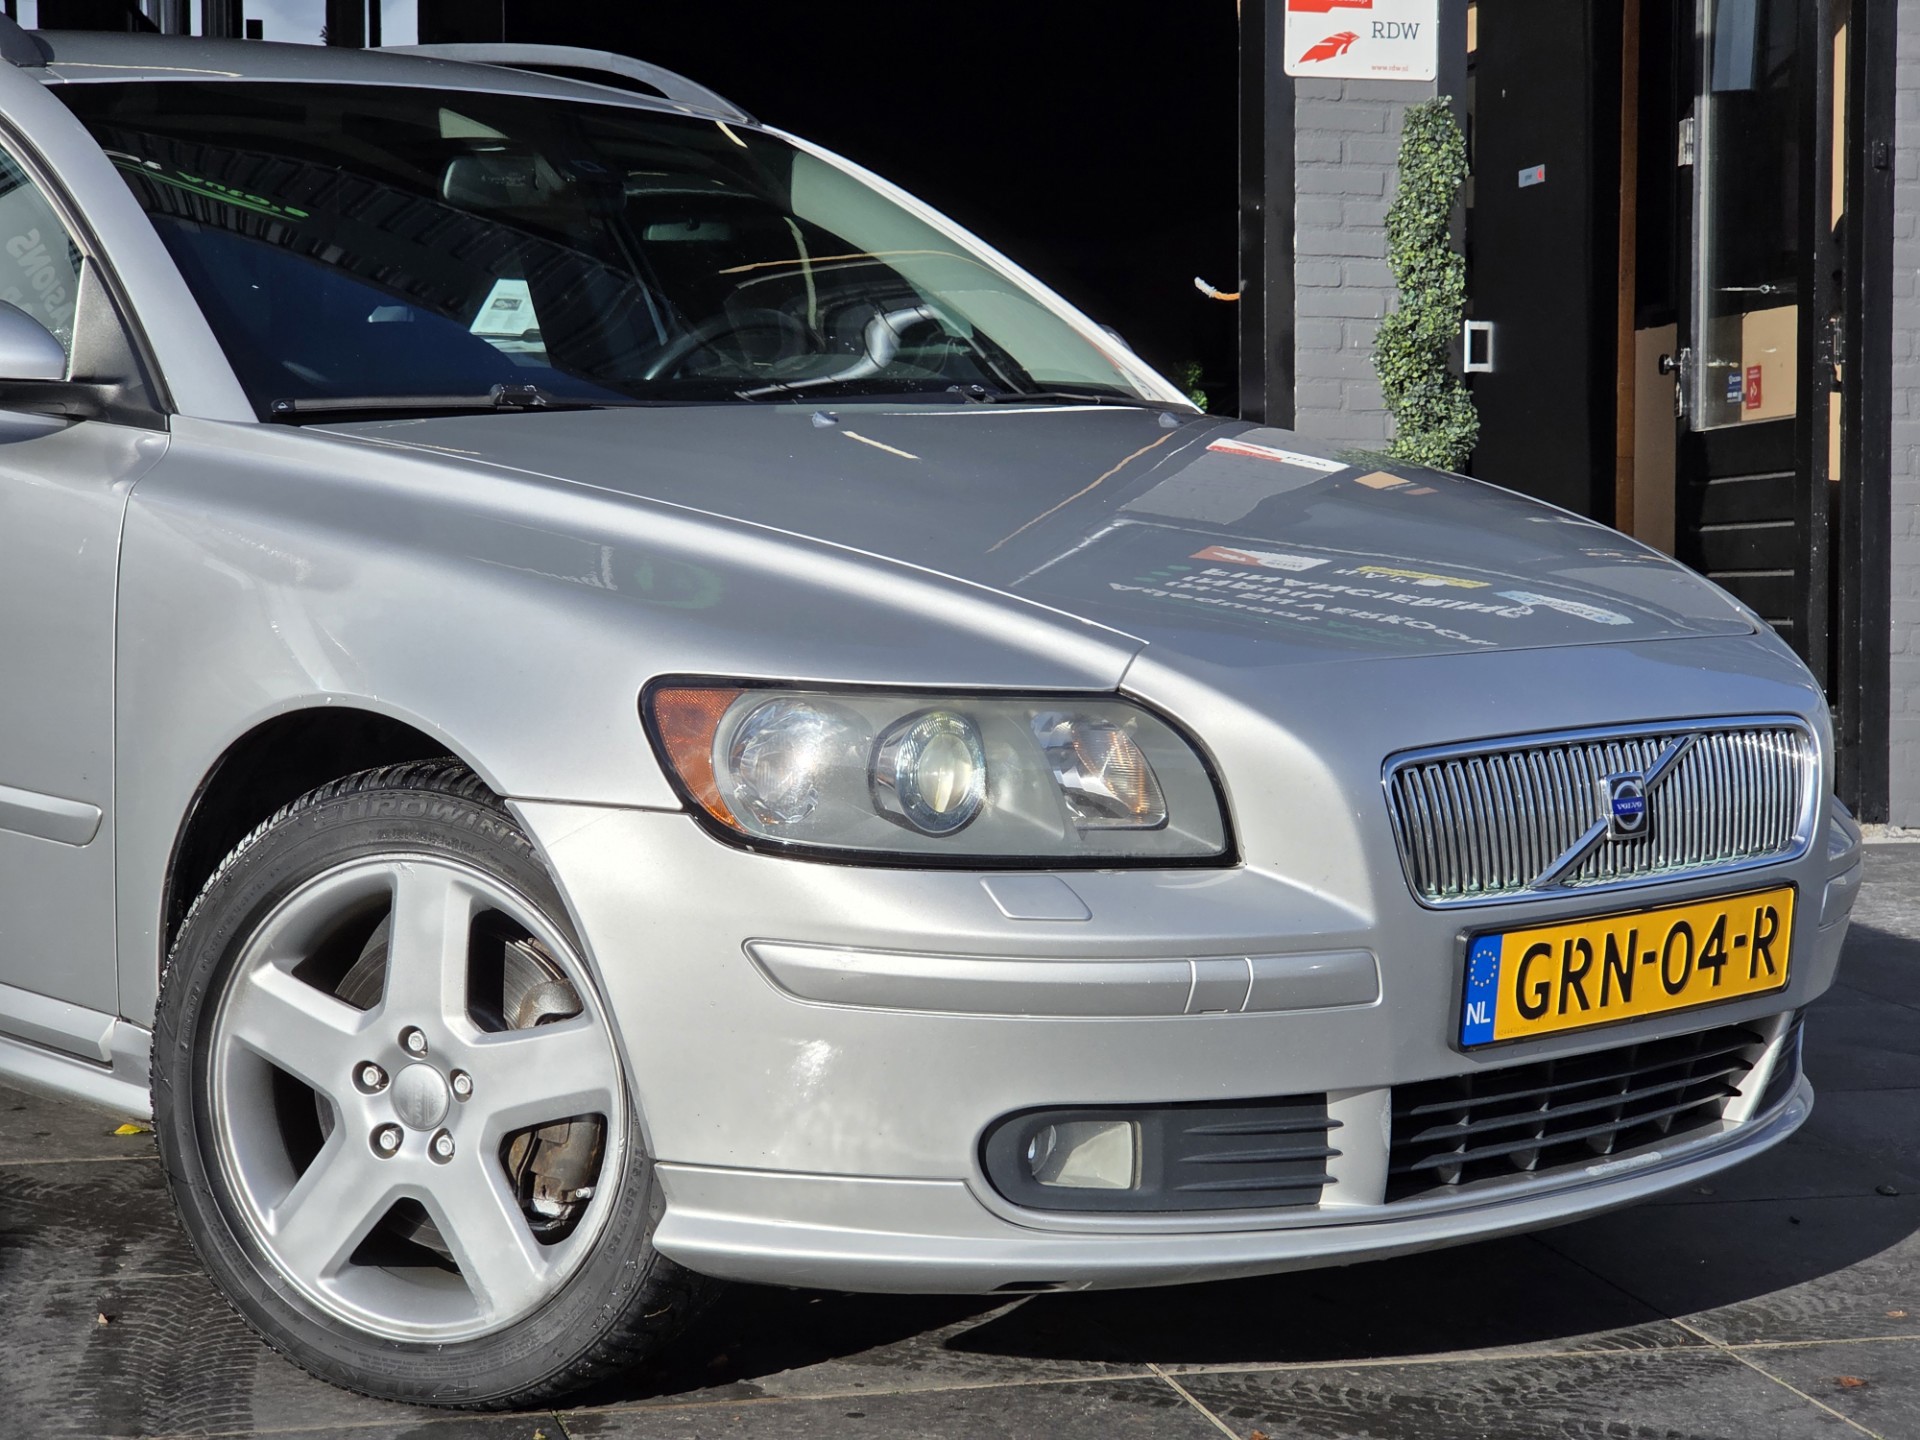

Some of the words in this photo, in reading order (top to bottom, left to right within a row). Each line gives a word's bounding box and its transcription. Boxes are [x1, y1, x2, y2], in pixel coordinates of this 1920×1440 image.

[1371, 21, 1420, 39] RDW
[1616, 801, 1642, 810] VOLVO
[1515, 905, 1778, 1020] GRN-04-R
[1466, 1001, 1491, 1026] NL
